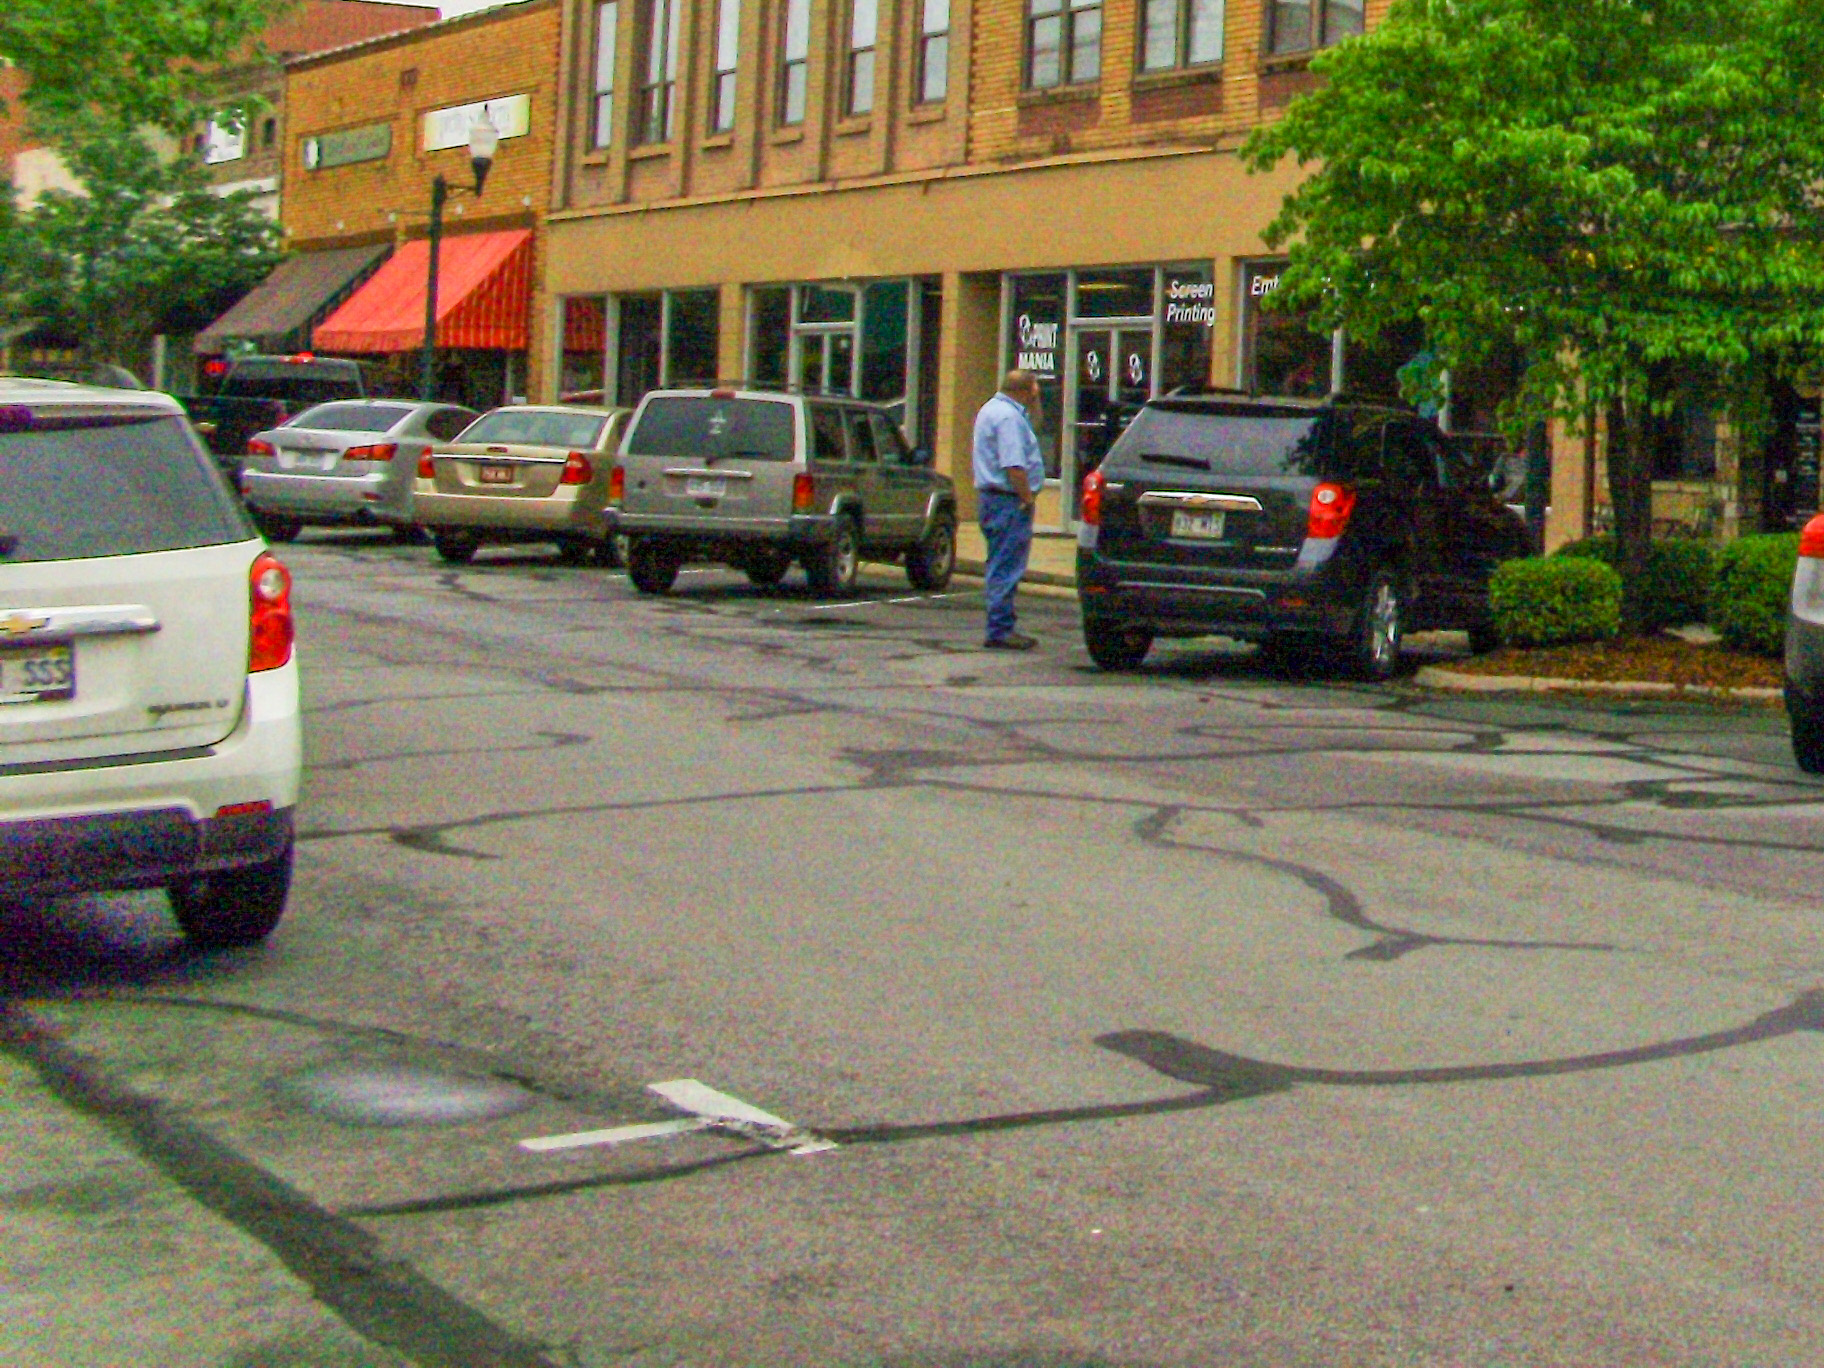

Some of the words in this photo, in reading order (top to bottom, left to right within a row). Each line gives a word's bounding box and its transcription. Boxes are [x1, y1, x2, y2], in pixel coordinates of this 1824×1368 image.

[1170, 280, 1213, 299] Screen
[1166, 302, 1215, 326] Printing
[1018, 353, 1054, 370] MANIA
